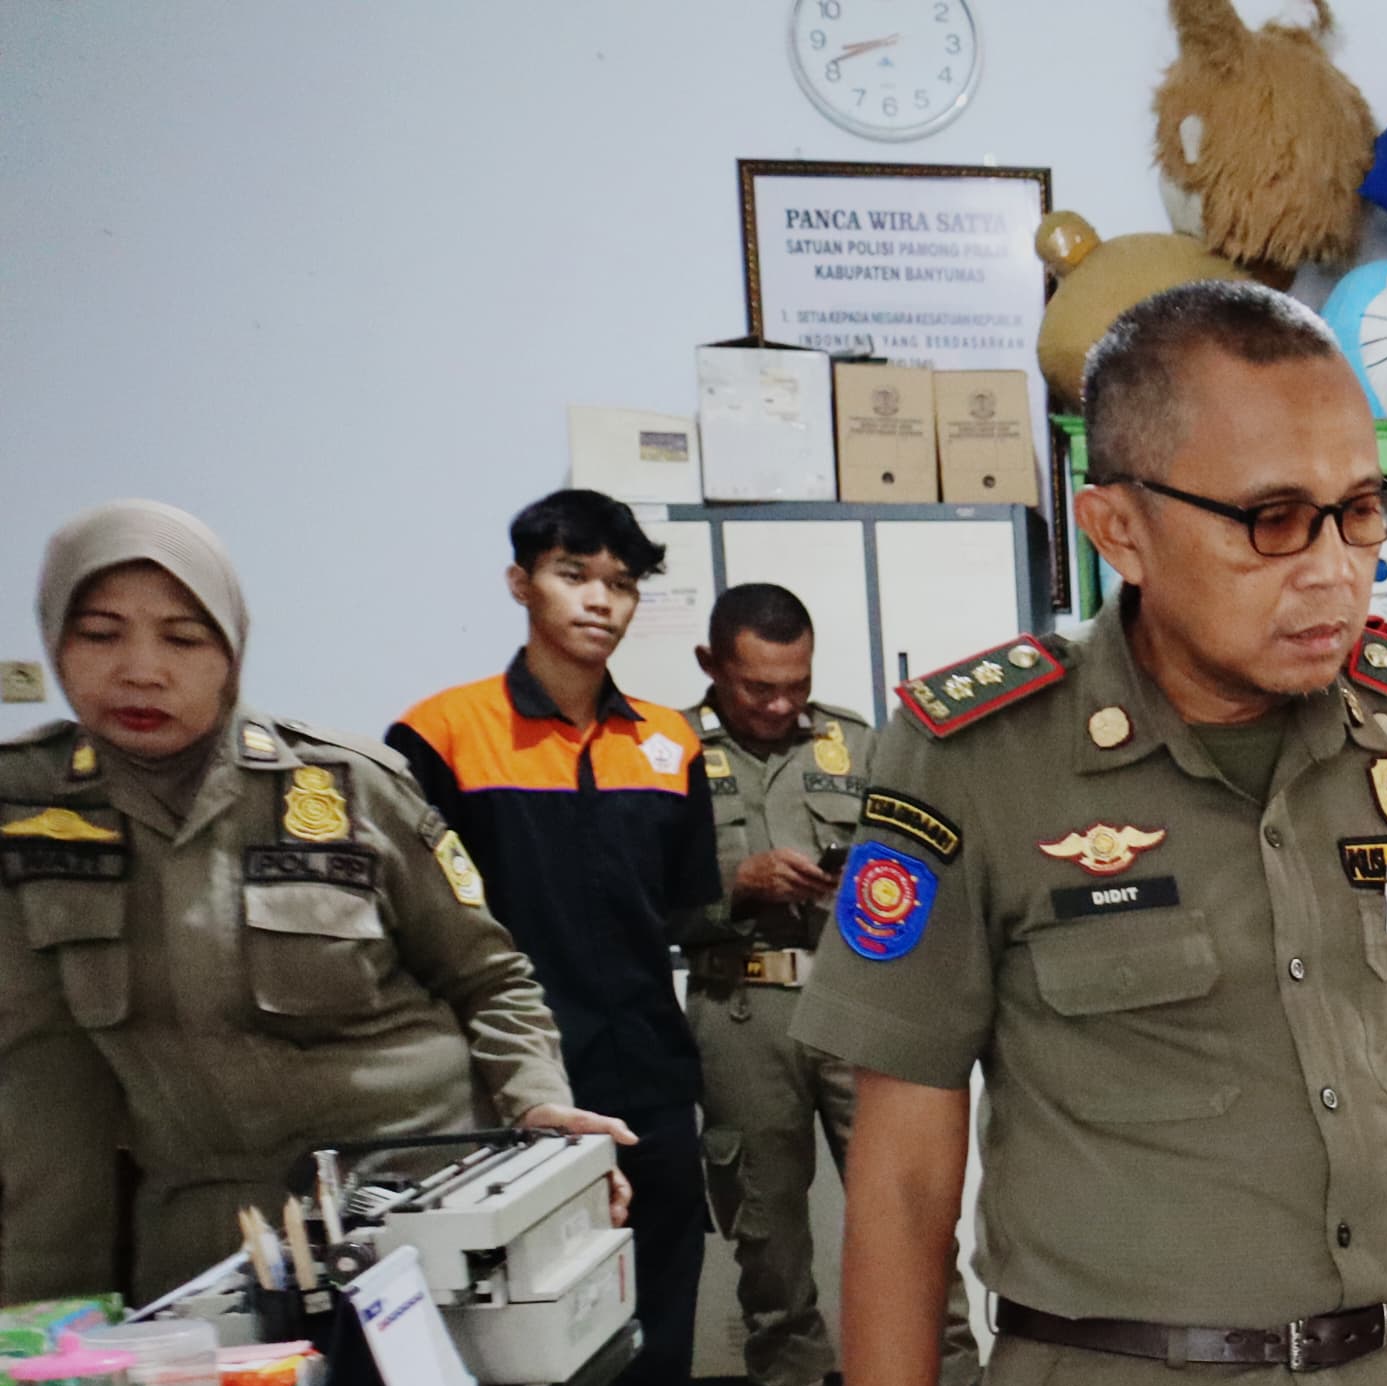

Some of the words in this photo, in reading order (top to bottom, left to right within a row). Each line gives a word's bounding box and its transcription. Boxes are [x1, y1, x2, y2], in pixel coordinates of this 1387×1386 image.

[818, 0, 841, 20] 10
[933, 2, 950, 23] 2
[810, 29, 827, 49] 9
[945, 33, 961, 54] 3
[825, 60, 841, 82] 8
[937, 66, 953, 83] 4
[852, 88, 867, 107] 7
[882, 96, 898, 117] 6
[914, 89, 930, 109] 5
[785, 209, 861, 231] PANCA
[869, 211, 930, 232] WIRA
[786, 240, 843, 255] SATUAN
[847, 241, 894, 255] POLISI
[814, 265, 900, 281] KABUPATEN
[905, 266, 985, 283] BANYUMAS
[259, 854, 323, 877] POL
[327, 856, 366, 880] PP
[1091, 887, 1139, 905] DIDIT
